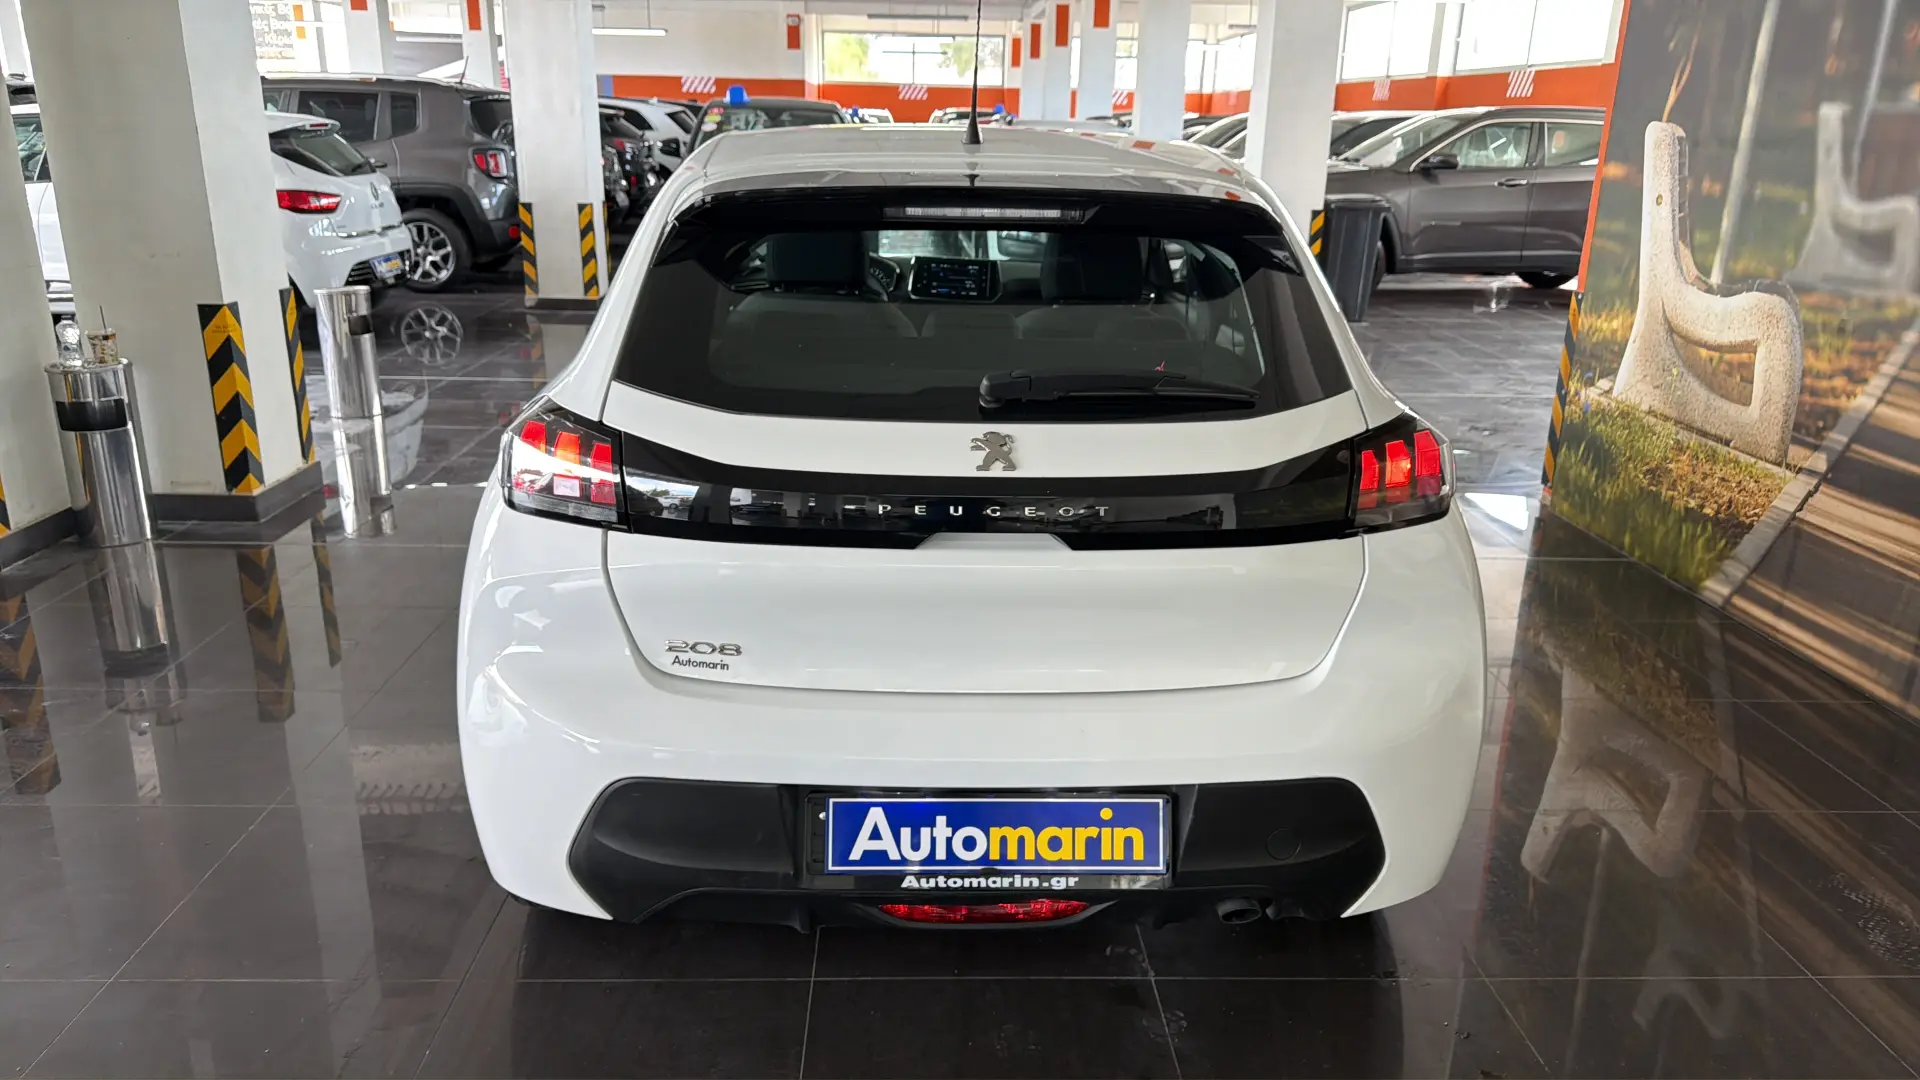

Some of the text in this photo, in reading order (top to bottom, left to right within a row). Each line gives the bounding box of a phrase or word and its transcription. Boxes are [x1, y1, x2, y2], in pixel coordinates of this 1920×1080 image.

[878, 504, 1109, 517] PEUGEOT
[665, 639, 743, 656] 208
[671, 655, 730, 671] Automarin
[848, 806, 1145, 861] Automarin
[900, 874, 1079, 890] Automarin.gr
